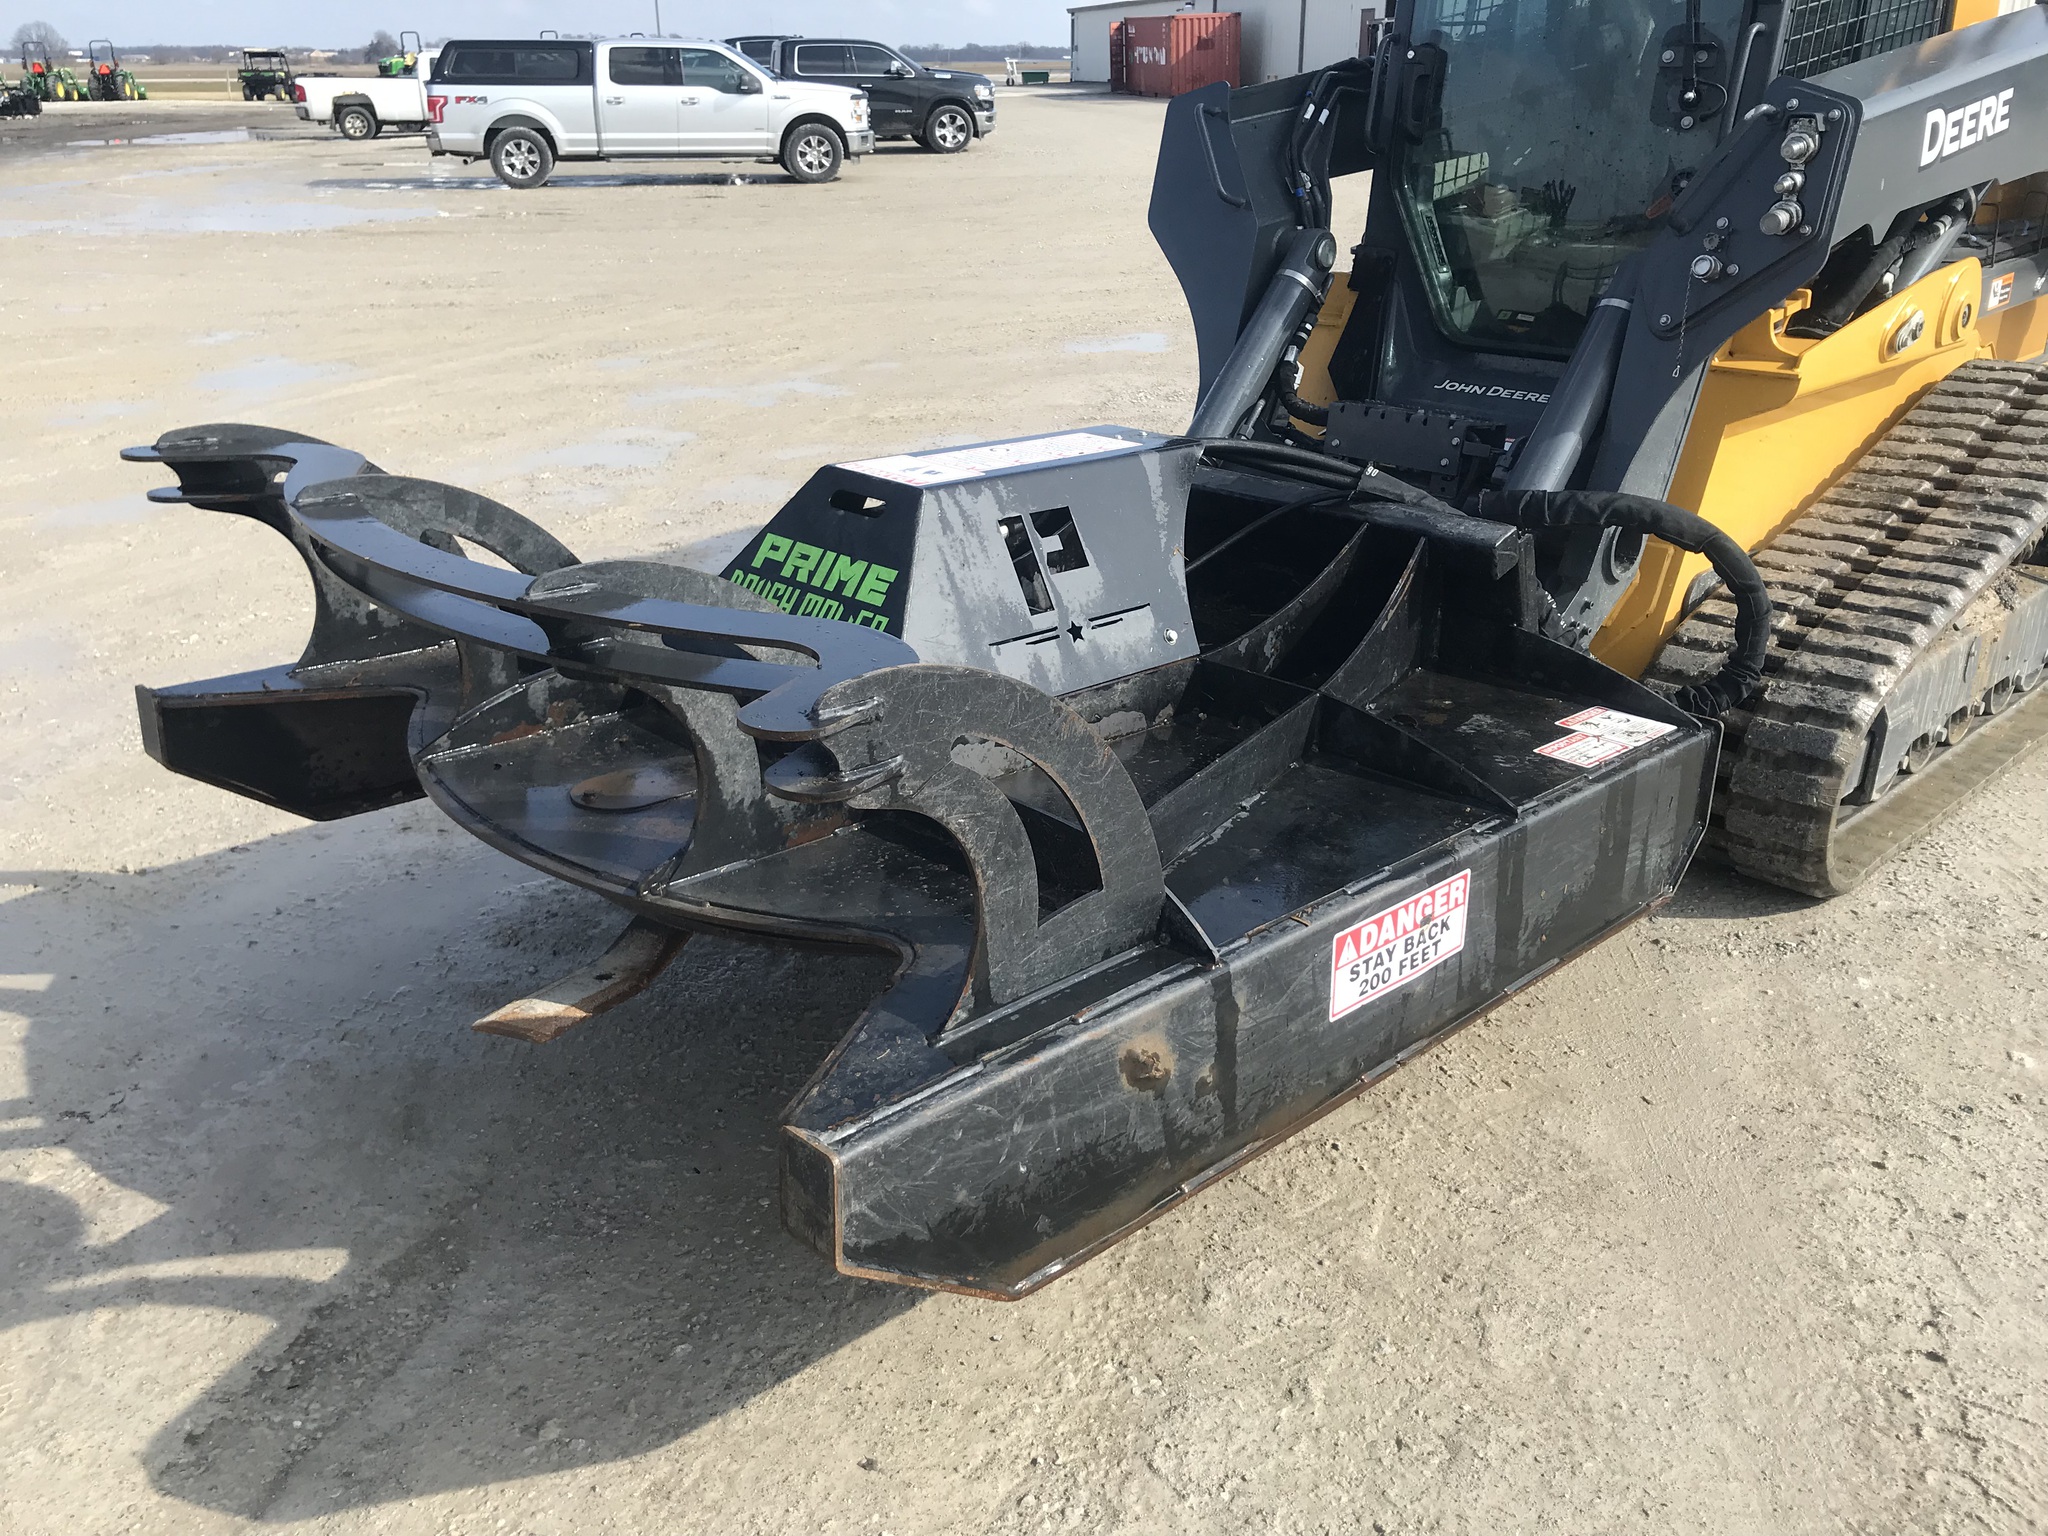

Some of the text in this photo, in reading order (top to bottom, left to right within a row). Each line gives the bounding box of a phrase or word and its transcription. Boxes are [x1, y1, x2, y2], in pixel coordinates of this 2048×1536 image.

[1920, 87, 2015, 167] DEERE
[1433, 379, 1551, 403] JOHN DEERE
[751, 532, 899, 607] PRIME
[1350, 915, 1451, 982] STAY BACK
[1360, 878, 1466, 956] DANGER
[1358, 939, 1442, 997] 200 FEET
